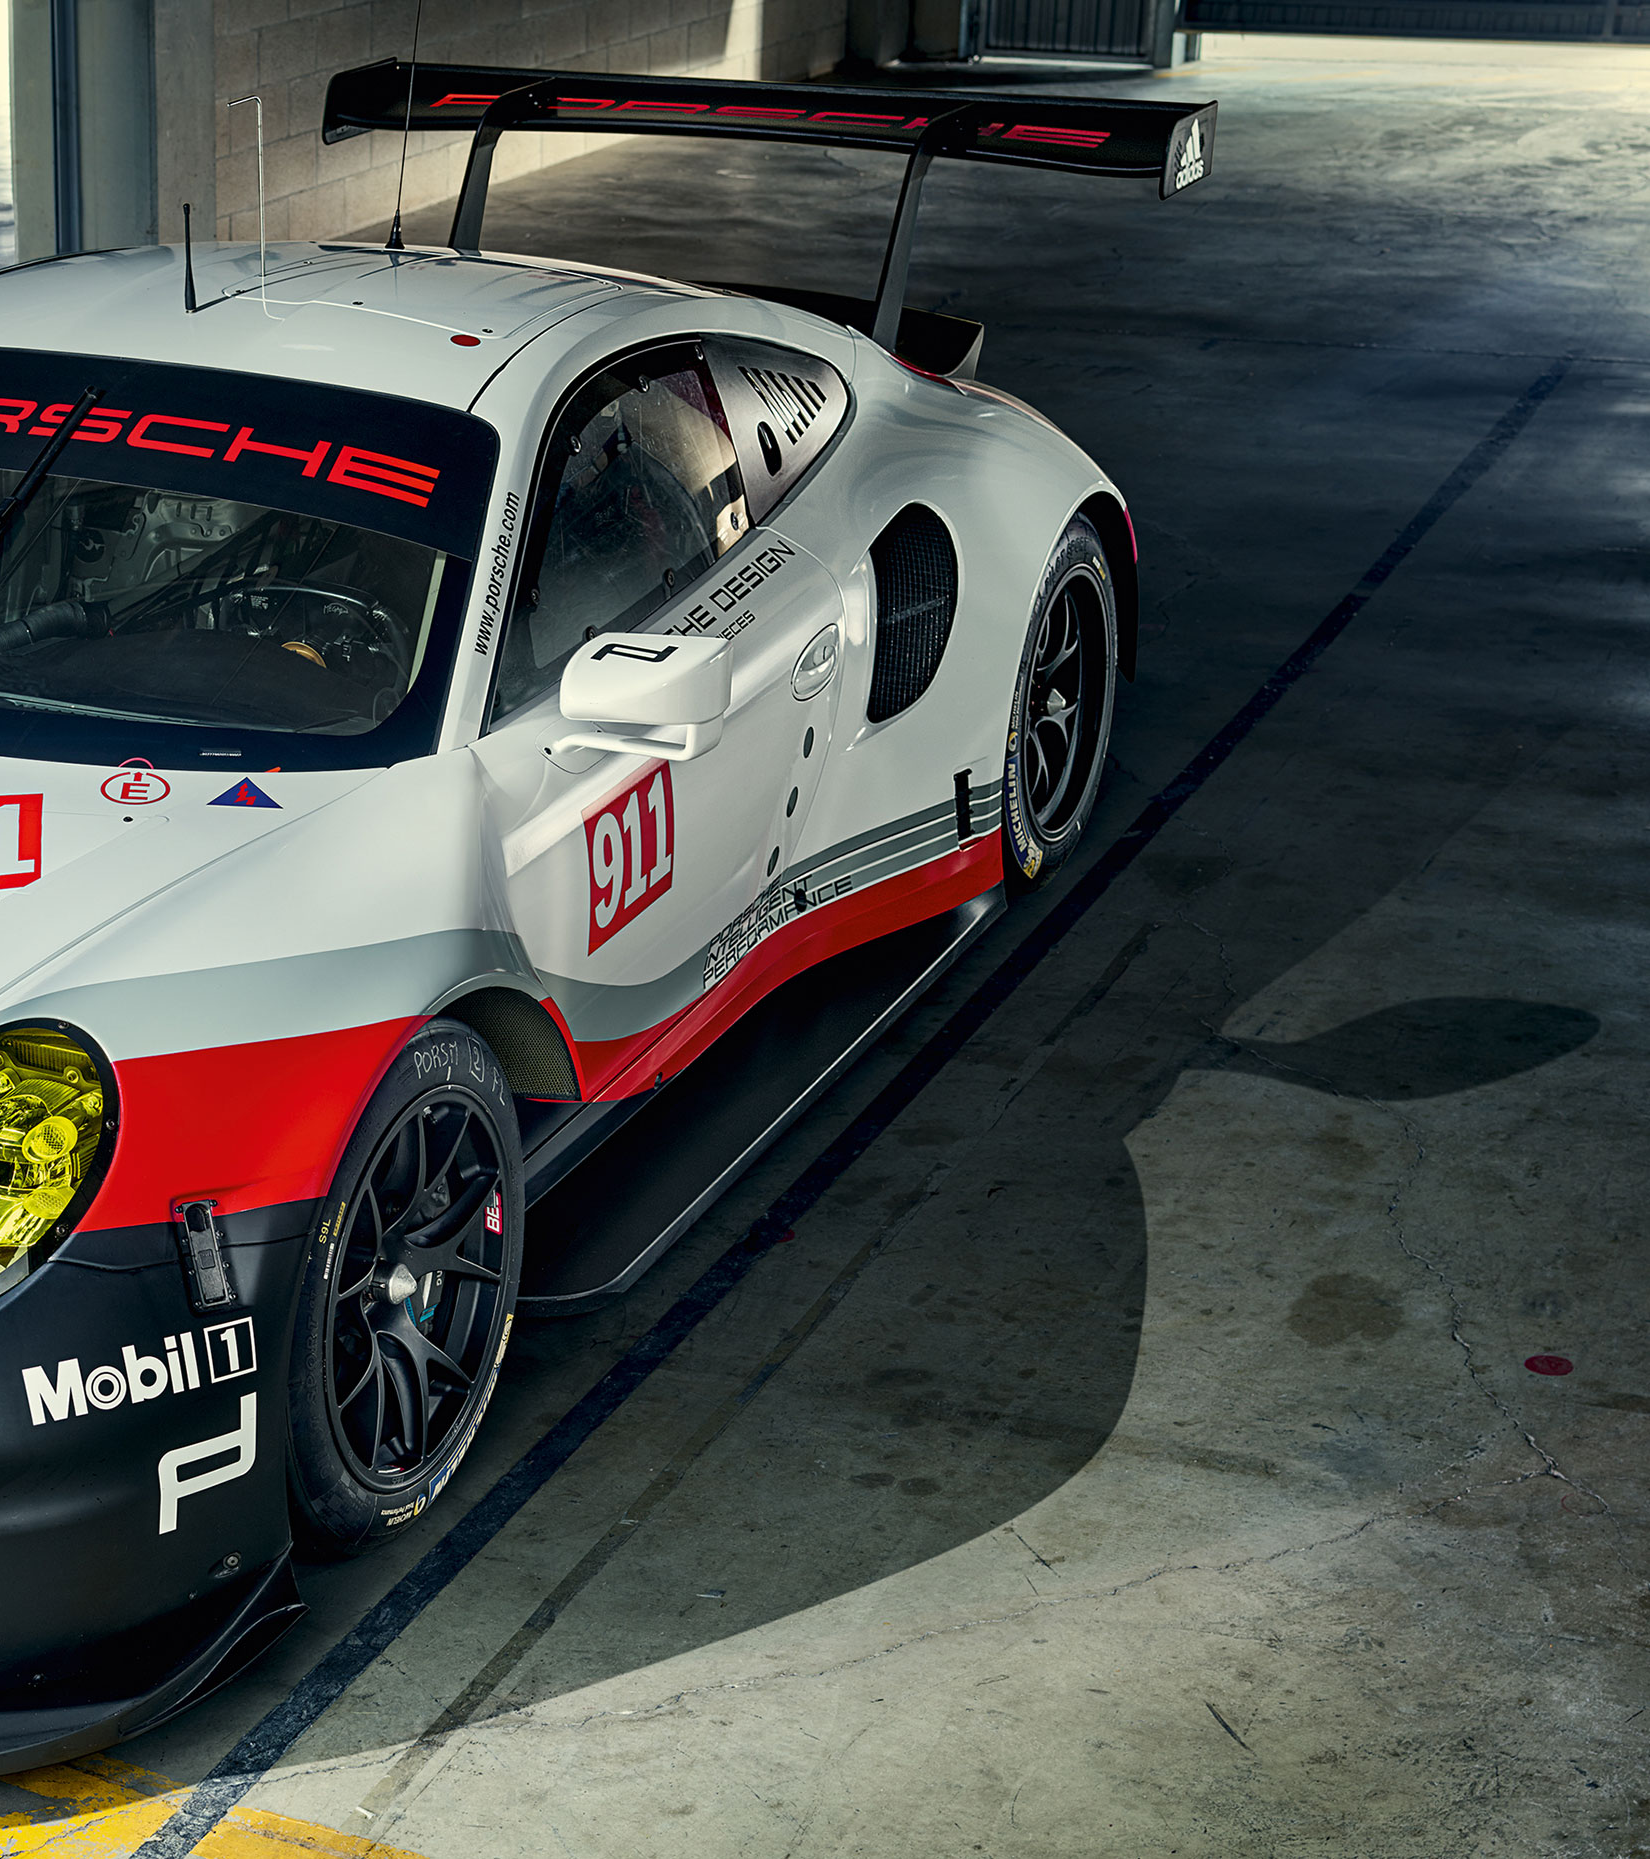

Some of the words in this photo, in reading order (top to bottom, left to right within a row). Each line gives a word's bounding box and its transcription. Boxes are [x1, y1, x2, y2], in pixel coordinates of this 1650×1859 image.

[1175, 159, 1204, 190] adidas
[474, 491, 521, 656] www.porsche.com
[708, 539, 796, 613] DESIGN
[120, 782, 151, 801] E
[1007, 763, 1028, 852] MICHELIN
[592, 771, 672, 929] 911
[704, 874, 813, 971] INTELLIGENT
[707, 874, 782, 954] PORSCHE
[318, 1219, 332, 1244] S9L
[21, 1332, 201, 1426] Mobil
